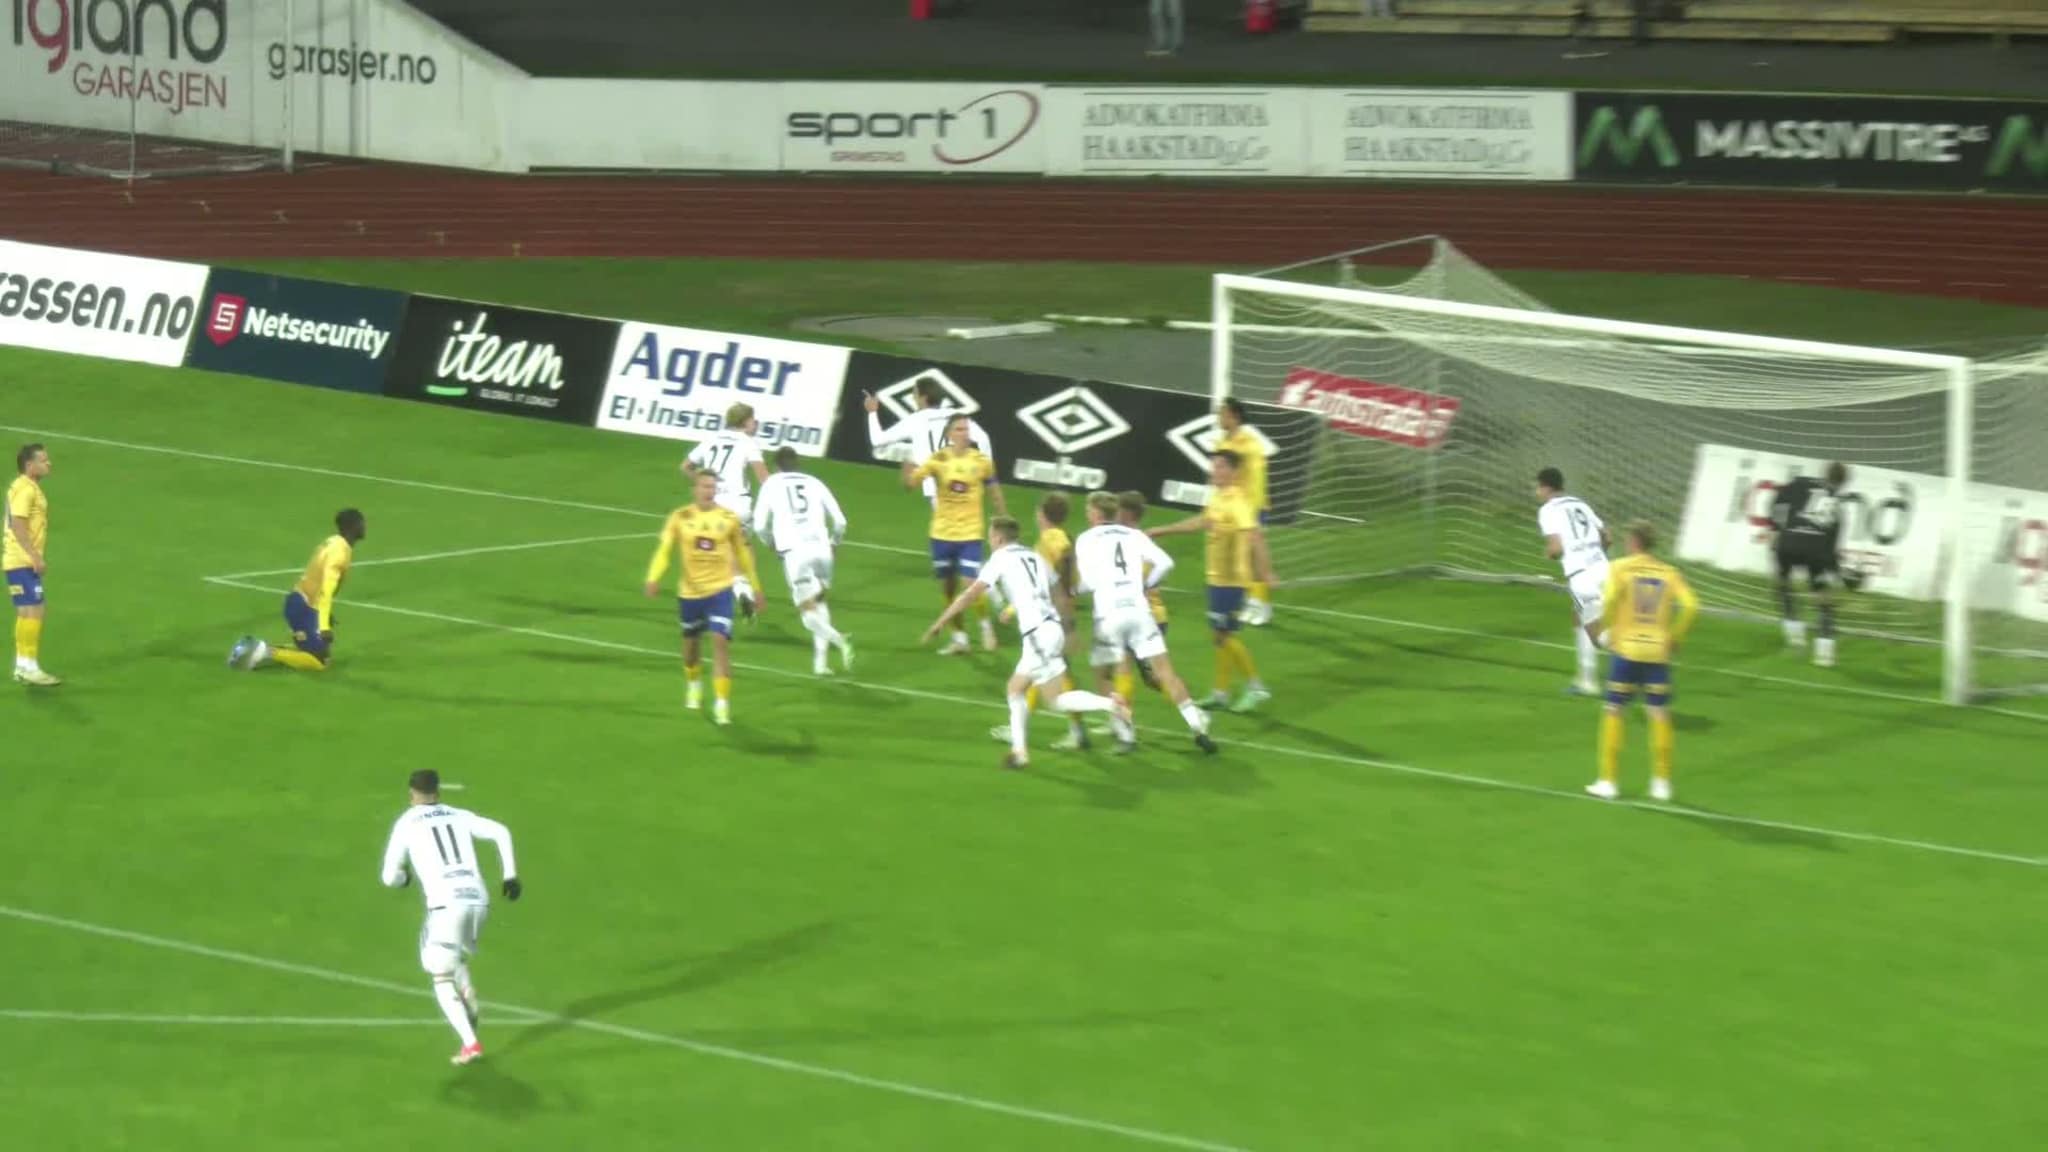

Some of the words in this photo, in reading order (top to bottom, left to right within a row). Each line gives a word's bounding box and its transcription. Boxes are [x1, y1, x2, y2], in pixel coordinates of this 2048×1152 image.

[267, 42, 437, 86] garasjer.no
[72, 61, 227, 115] GARASJEN
[786, 108, 958, 146] sport
[980, 107, 997, 139] 1
[1696, 119, 1962, 163] MASSIVTRE
[243, 306, 390, 360] Netsecurity
[436, 311, 566, 391] iteam
[619, 331, 803, 397] Agder
[1013, 456, 1107, 490] umbro
[786, 484, 809, 514] 15
[1566, 507, 1590, 541] 19
[1113, 541, 1127, 576] 4
[431, 823, 463, 866] 11
